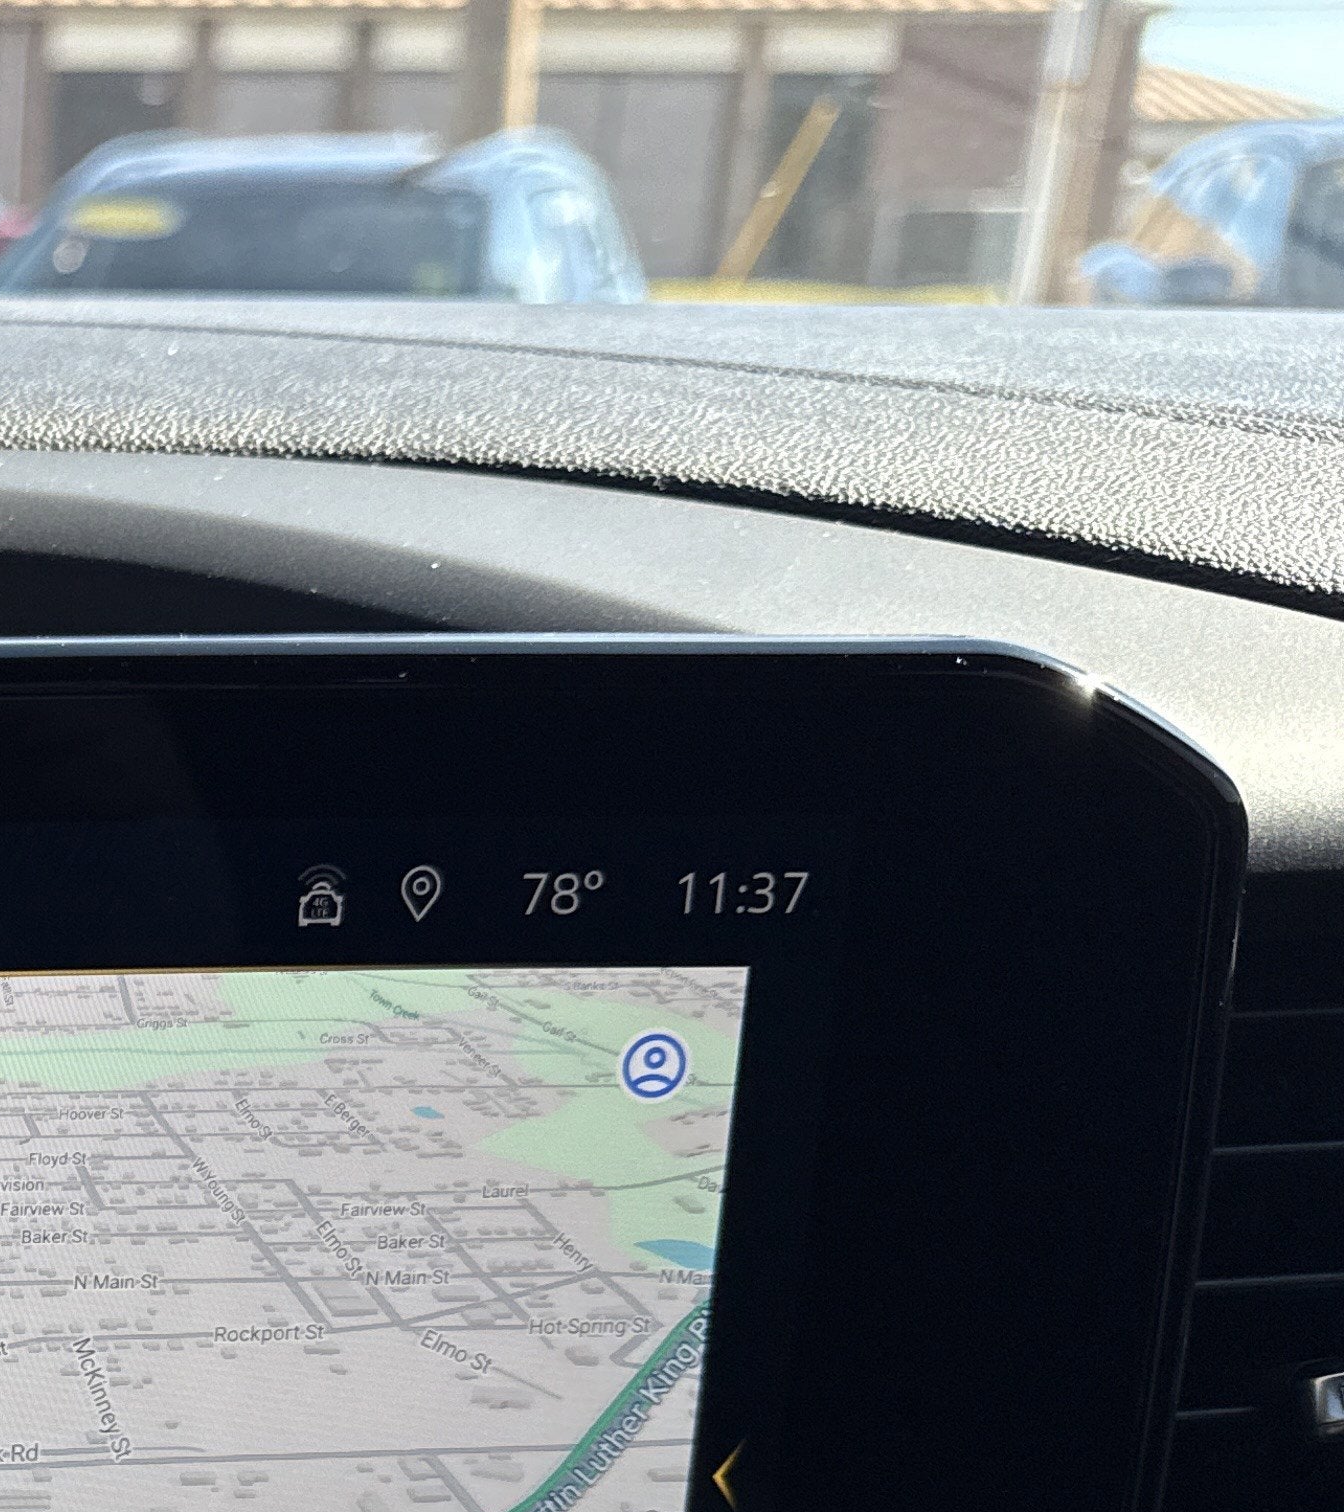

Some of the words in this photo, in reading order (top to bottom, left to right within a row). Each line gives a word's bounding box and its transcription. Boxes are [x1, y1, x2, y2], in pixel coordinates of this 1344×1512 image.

[522, 870, 605, 916] 78°
[678, 871, 809, 915] 11:37
[176, 1016, 190, 1029] St
[319, 1033, 356, 1045] Cross
[358, 1033, 371, 1045] St
[59, 1106, 104, 1121] Hoover
[107, 1106, 124, 1120] St
[234, 1097, 262, 1130] Elmo
[257, 1124, 274, 1141] St
[333, 1102, 372, 1139] Berger
[28, 1151, 69, 1170] Floyd
[72, 1151, 87, 1165] St
[202, 1169, 236, 1218] Young
[228, 1206, 246, 1226] St
[481, 1183, 530, 1200] Laurel
[0, 1201, 65, 1218] Fairview
[68, 1201, 86, 1218] St
[340, 1201, 407, 1218] Fairview
[410, 1201, 428, 1217] St
[21, 1229, 68, 1245] Baker
[72, 1229, 89, 1245] St
[376, 1234, 424, 1251] Baker
[428, 1233, 445, 1250] St
[315, 1219, 352, 1264] Elmo
[342, 1254, 365, 1280] St
[552, 1232, 595, 1274] Henry
[73, 1274, 87, 1291] N
[90, 1274, 138, 1290] Main
[140, 1273, 159, 1290] St
[365, 1270, 380, 1287] N
[382, 1269, 429, 1286] Main
[431, 1269, 450, 1286] St
[213, 1323, 296, 1346] Rockport
[300, 1323, 325, 1342] St
[528, 1318, 562, 1336] Hot
[566, 1318, 630, 1339] Spring
[632, 1317, 652, 1335] St
[420, 1329, 463, 1363] Elmo
[463, 1352, 493, 1375] St
[72, 1336, 123, 1438] McKinney
[109, 1434, 132, 1461] St
[574, 1408, 649, 1490] Luther
[638, 1340, 701, 1403] King
[8, 1442, 39, 1462] Rd
